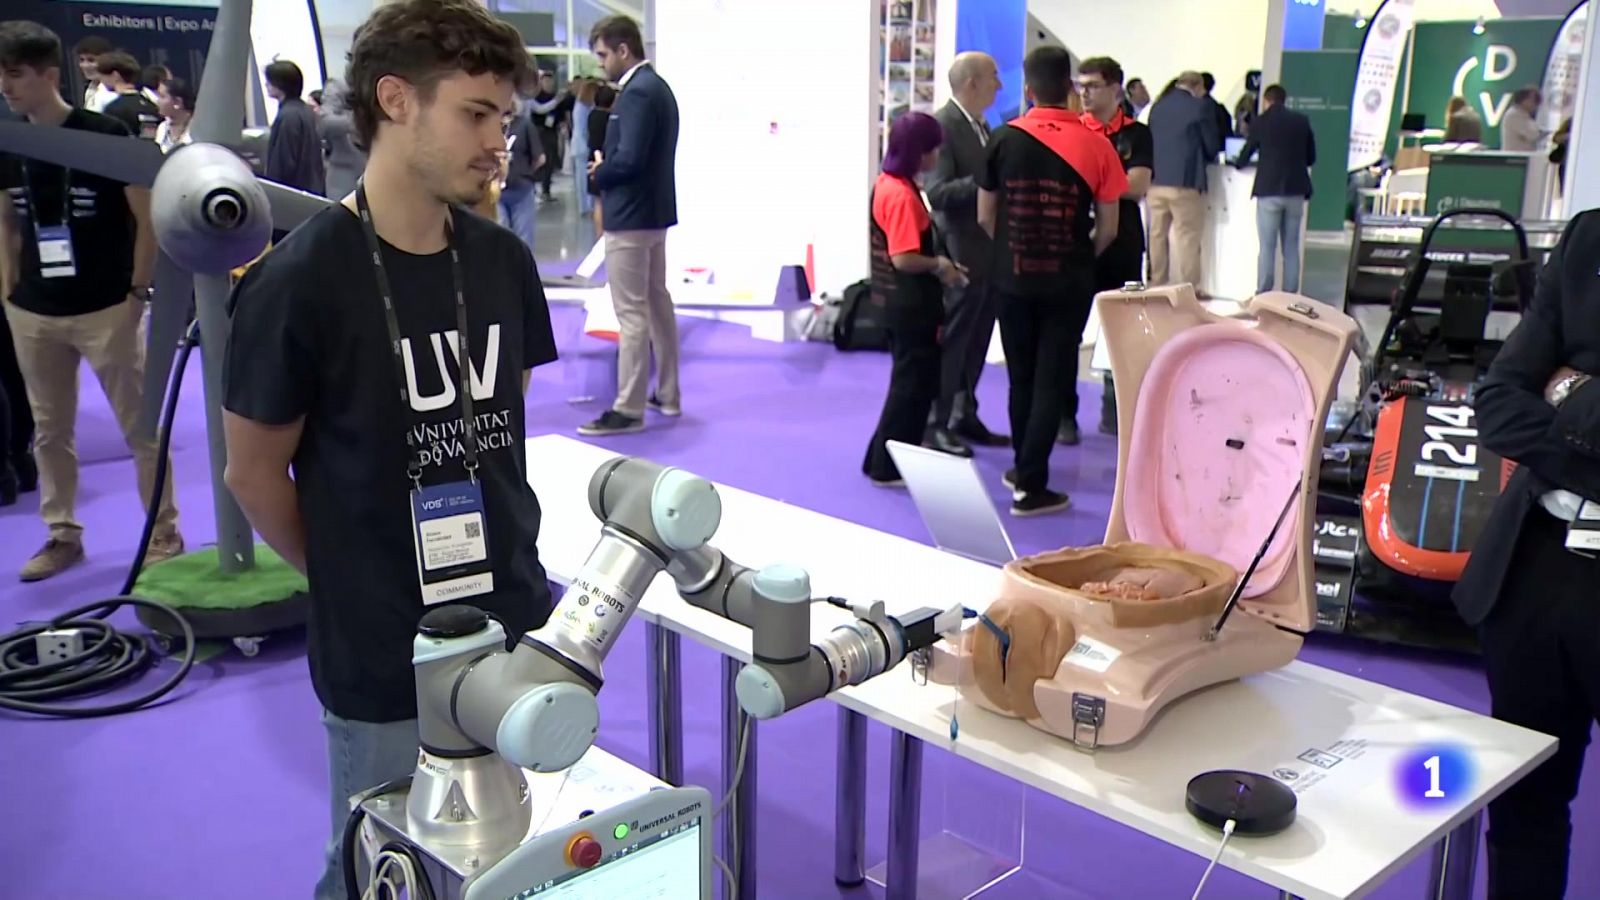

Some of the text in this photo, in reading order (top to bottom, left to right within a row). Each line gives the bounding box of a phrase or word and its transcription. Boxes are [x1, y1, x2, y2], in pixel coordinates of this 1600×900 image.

[83, 13, 156, 29] Exhibitors
[164, 16, 199, 32] Expo
[1483, 45, 1517, 81] D
[401, 324, 500, 412] UV
[1421, 405, 1478, 465] 214
[436, 582, 482, 597] COMMUNITY
[640, 813, 676, 833] UNIVERSAL
[677, 801, 702, 817] ROBOTS
